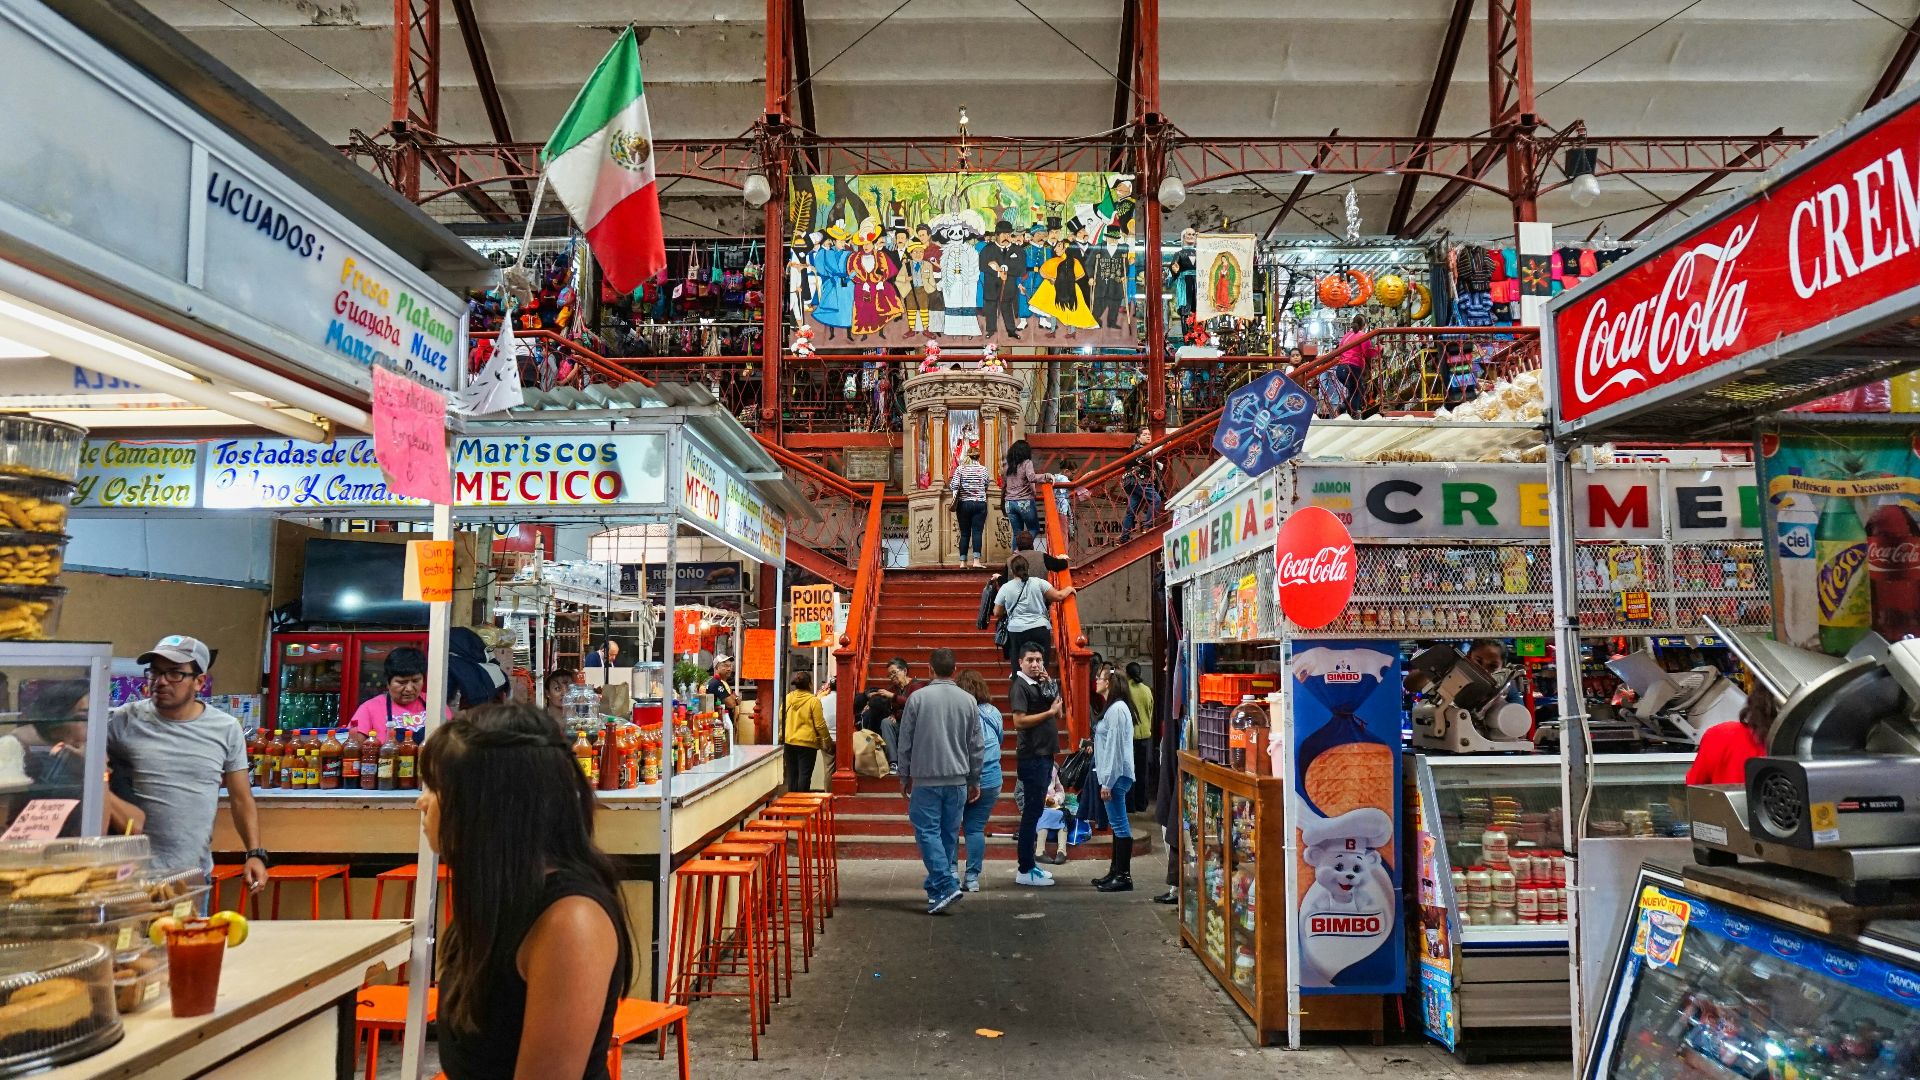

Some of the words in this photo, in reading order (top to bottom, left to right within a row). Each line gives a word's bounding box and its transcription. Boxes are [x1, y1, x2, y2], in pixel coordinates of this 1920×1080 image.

[341, 257, 390, 309] Fresa
[396, 292, 454, 346] Platano
[334, 290, 401, 347] Guayaba
[411, 332, 448, 372] Nuez
[104, 441, 197, 466] Camaron
[215, 440, 318, 466] Tostadas
[320, 440, 348, 464] de
[456, 436, 618, 464] Mariscos
[1312, 481, 1351, 493] JAMON
[1172, 497, 1258, 570] CREMERIA
[1786, 530, 1810, 548] ciel
[653, 567, 705, 580] REOÑO
[1278, 545, 1351, 587] Coca-Cola
[793, 607, 833, 622] FRESCO
[1327, 673, 1359, 681] BIMBO
[1345, 838, 1356, 850] B
[1642, 896, 1668, 907] NUEVO
[1311, 916, 1380, 932] BIMBO
[1825, 952, 1858, 971] DANONE
